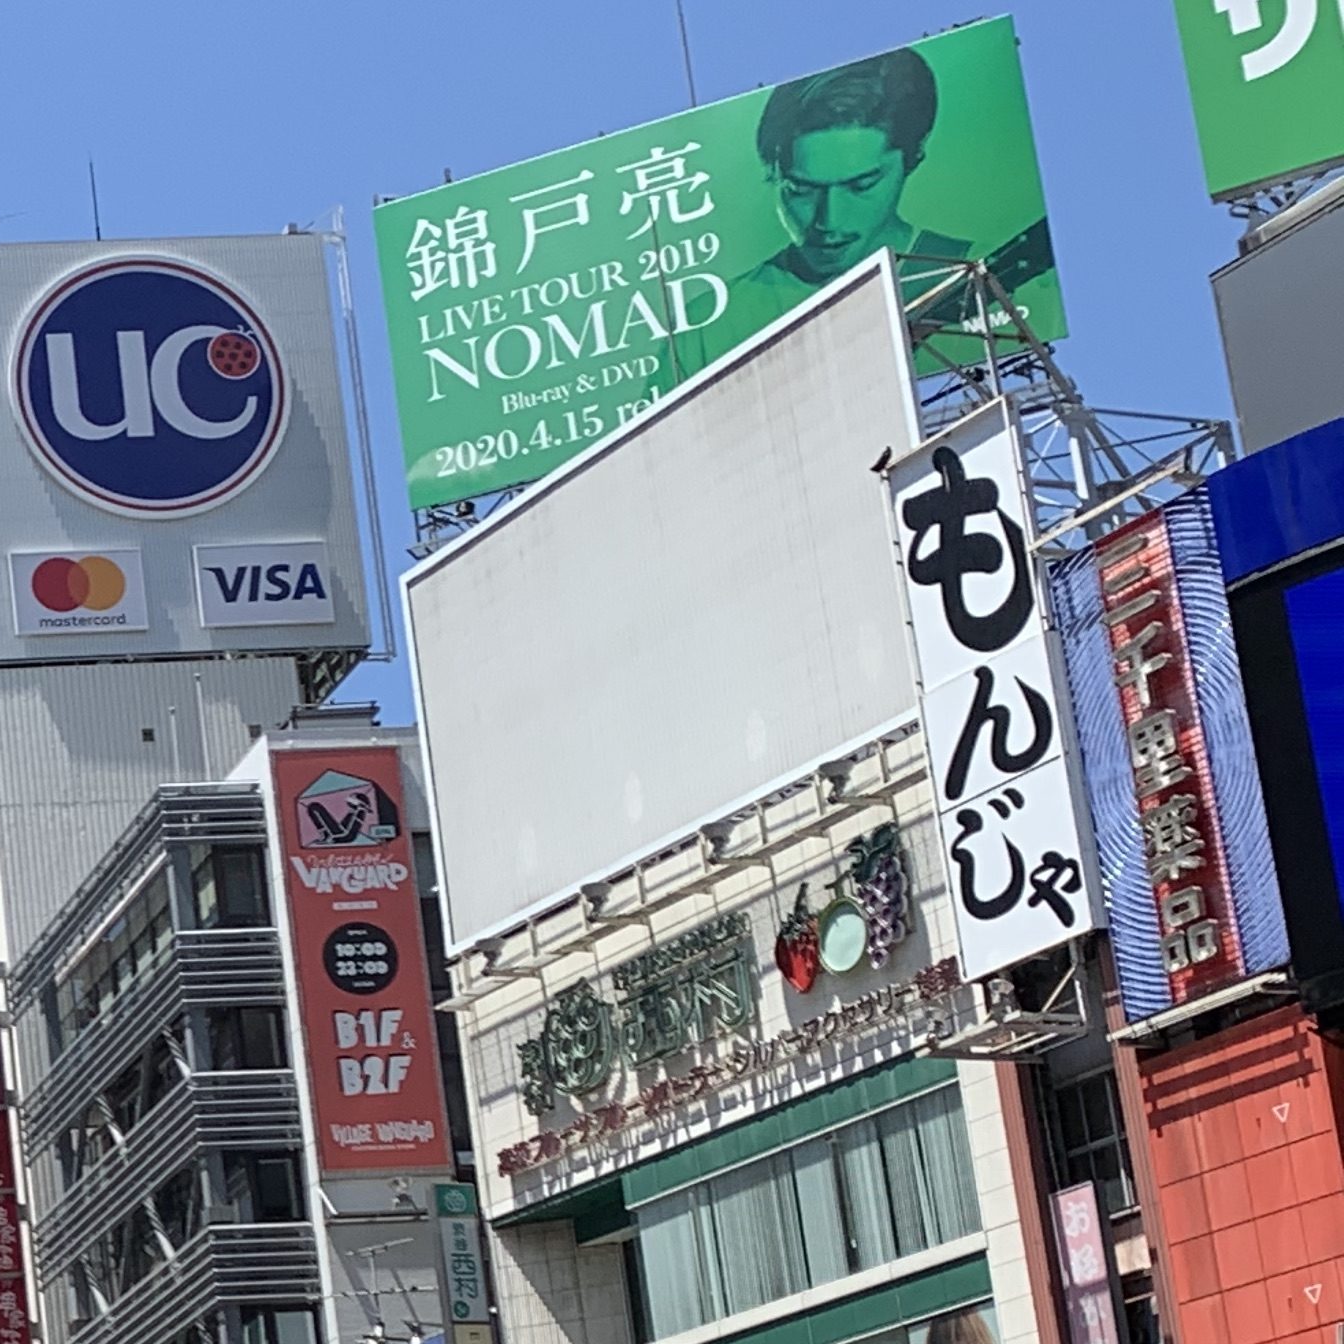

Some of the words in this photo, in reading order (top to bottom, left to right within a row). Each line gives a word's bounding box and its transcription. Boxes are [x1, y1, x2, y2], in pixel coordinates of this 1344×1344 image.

[406, 141, 715, 303] 錦戸亮
[418, 295, 506, 345] LIVE
[518, 260, 625, 317] TOUR
[638, 232, 721, 282] 2019
[422, 272, 729, 403] NOMAD
[46, 323, 259, 441] UC
[501, 379, 574, 416] Blu-ray
[575, 373, 598, 396] &
[600, 354, 661, 387] DVD
[435, 404, 605, 478] 2020.4.15
[39, 612, 127, 628] mastercard
[202, 562, 327, 604] VISA
[902, 446, 1083, 929] もんじゃ
[1098, 532, 1218, 973] 三千里薬品
[290, 856, 409, 894] VANGUARD
[333, 1008, 403, 1050] B1F
[339, 1055, 411, 1097] B2F
